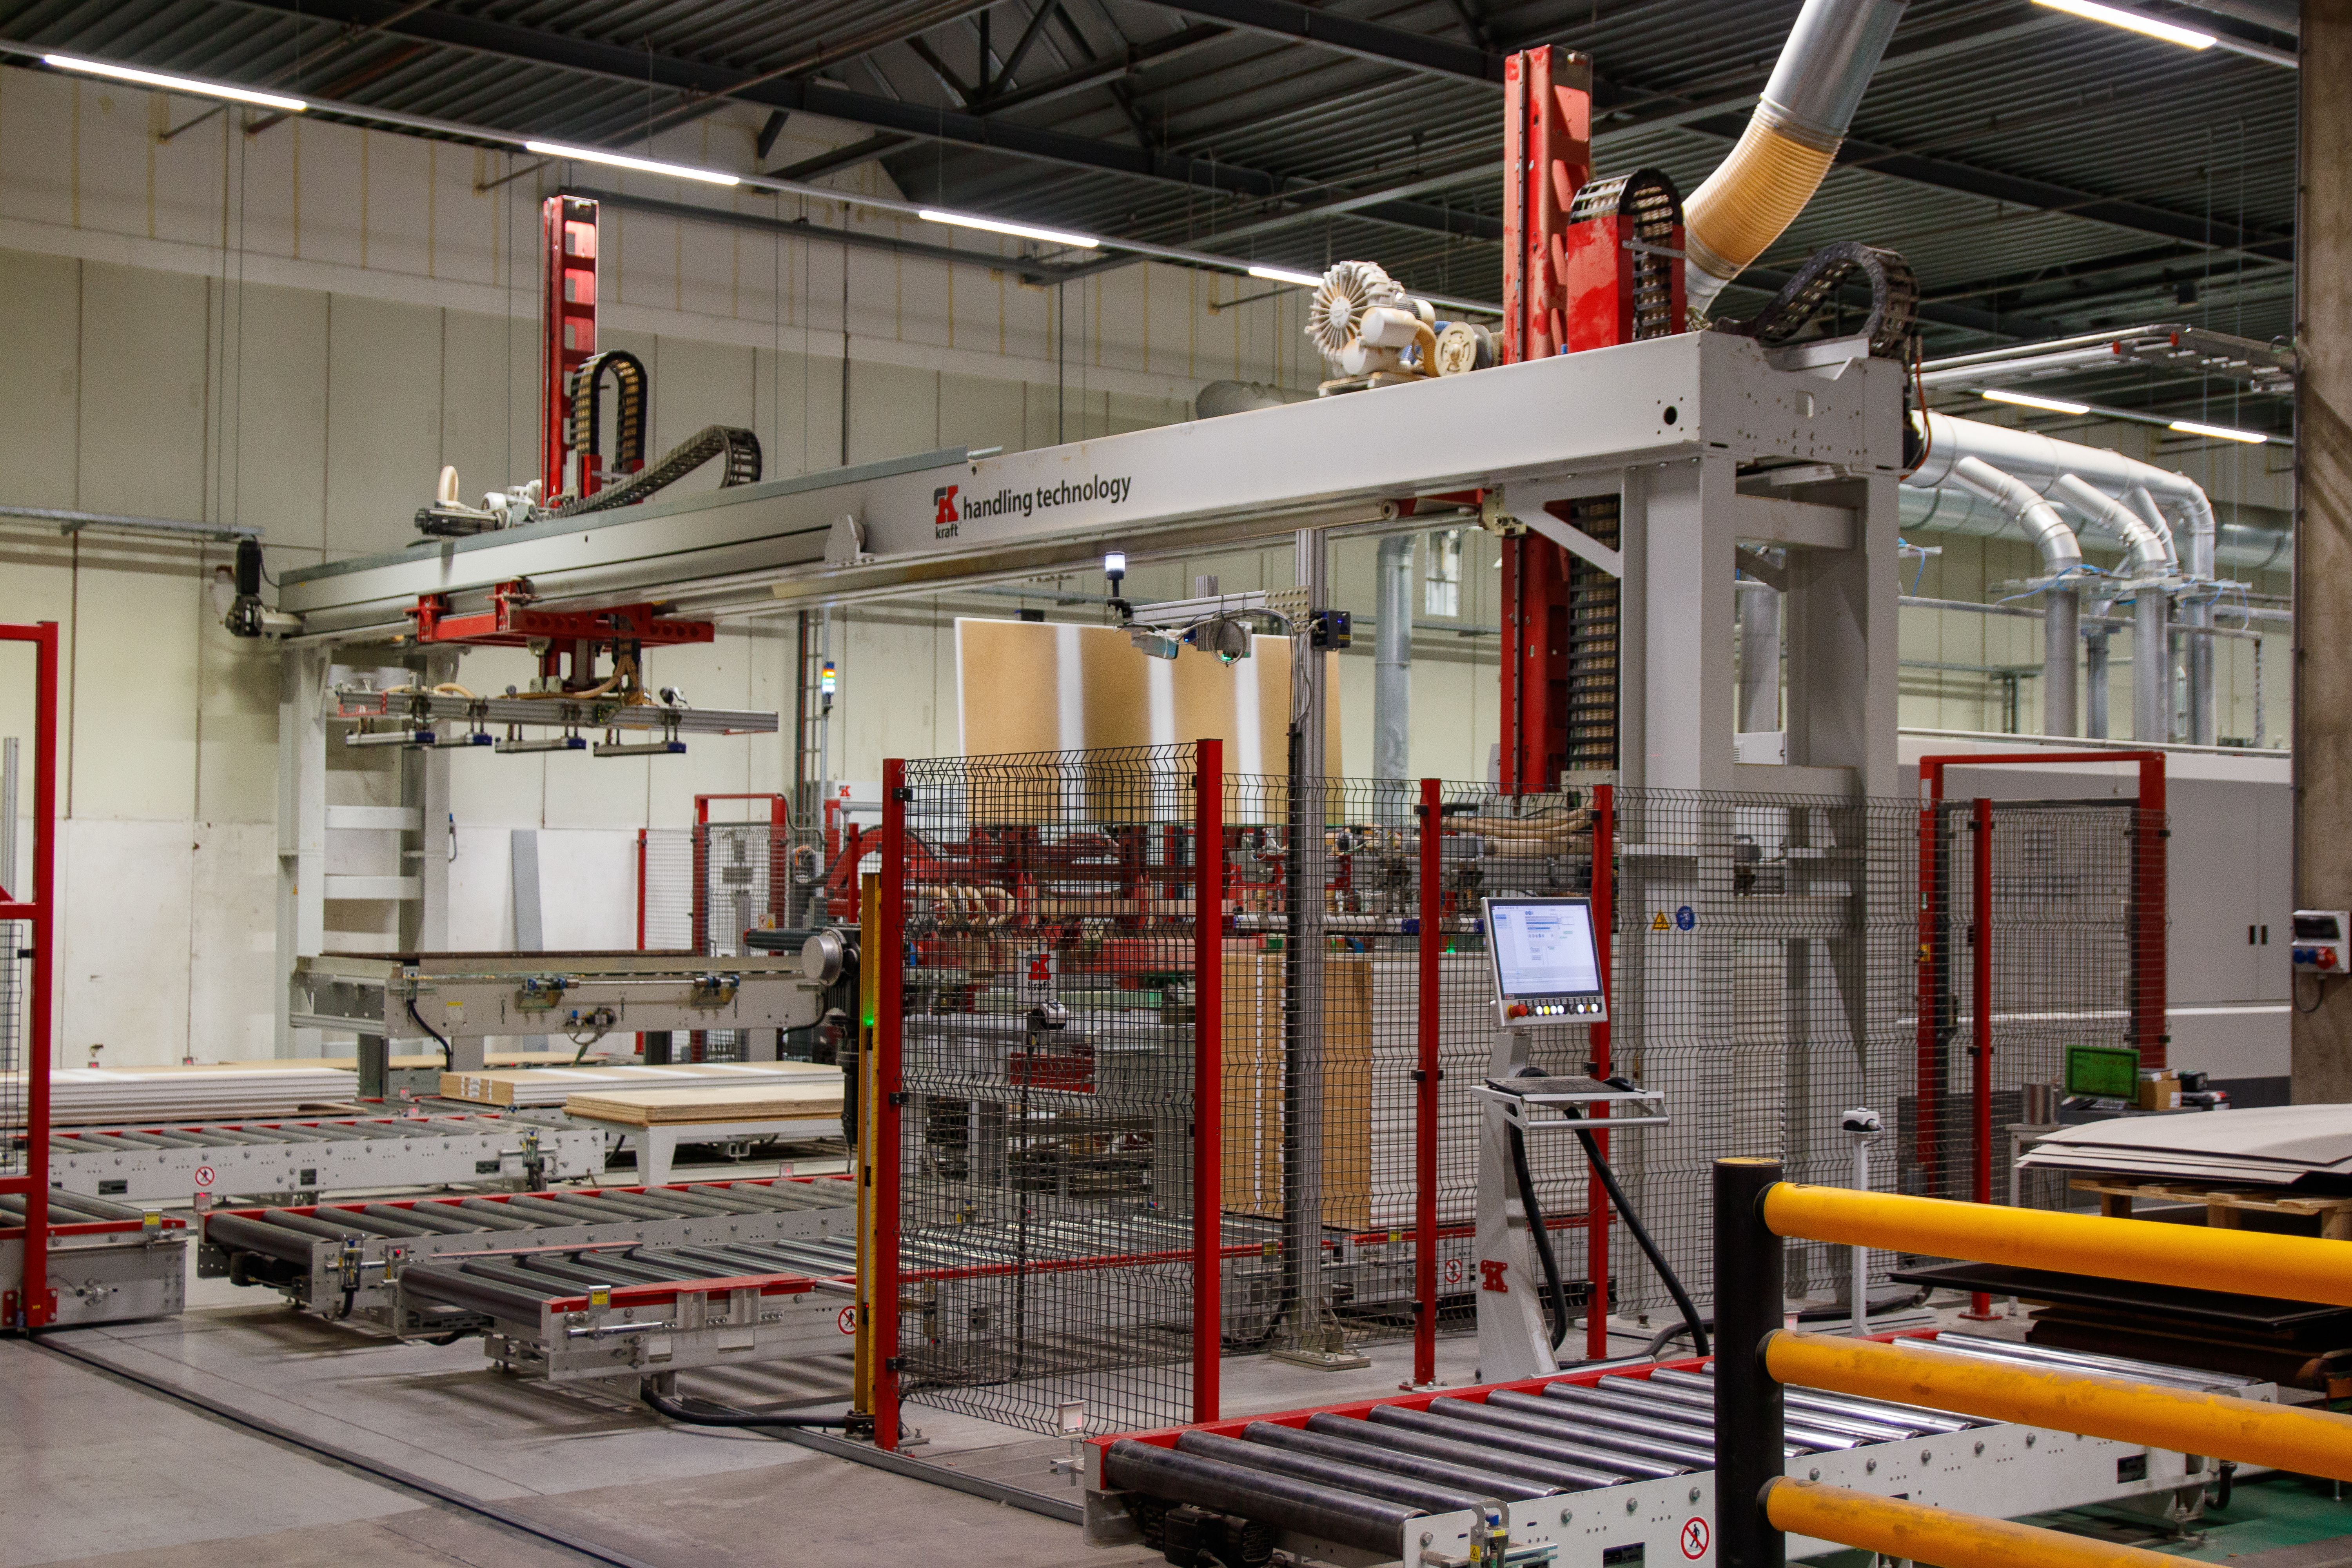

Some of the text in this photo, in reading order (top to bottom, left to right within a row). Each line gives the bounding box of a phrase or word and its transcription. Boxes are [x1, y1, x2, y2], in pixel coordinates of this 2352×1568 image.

[964, 474, 1132, 520] handling technology
[936, 523, 958, 539] kraft
